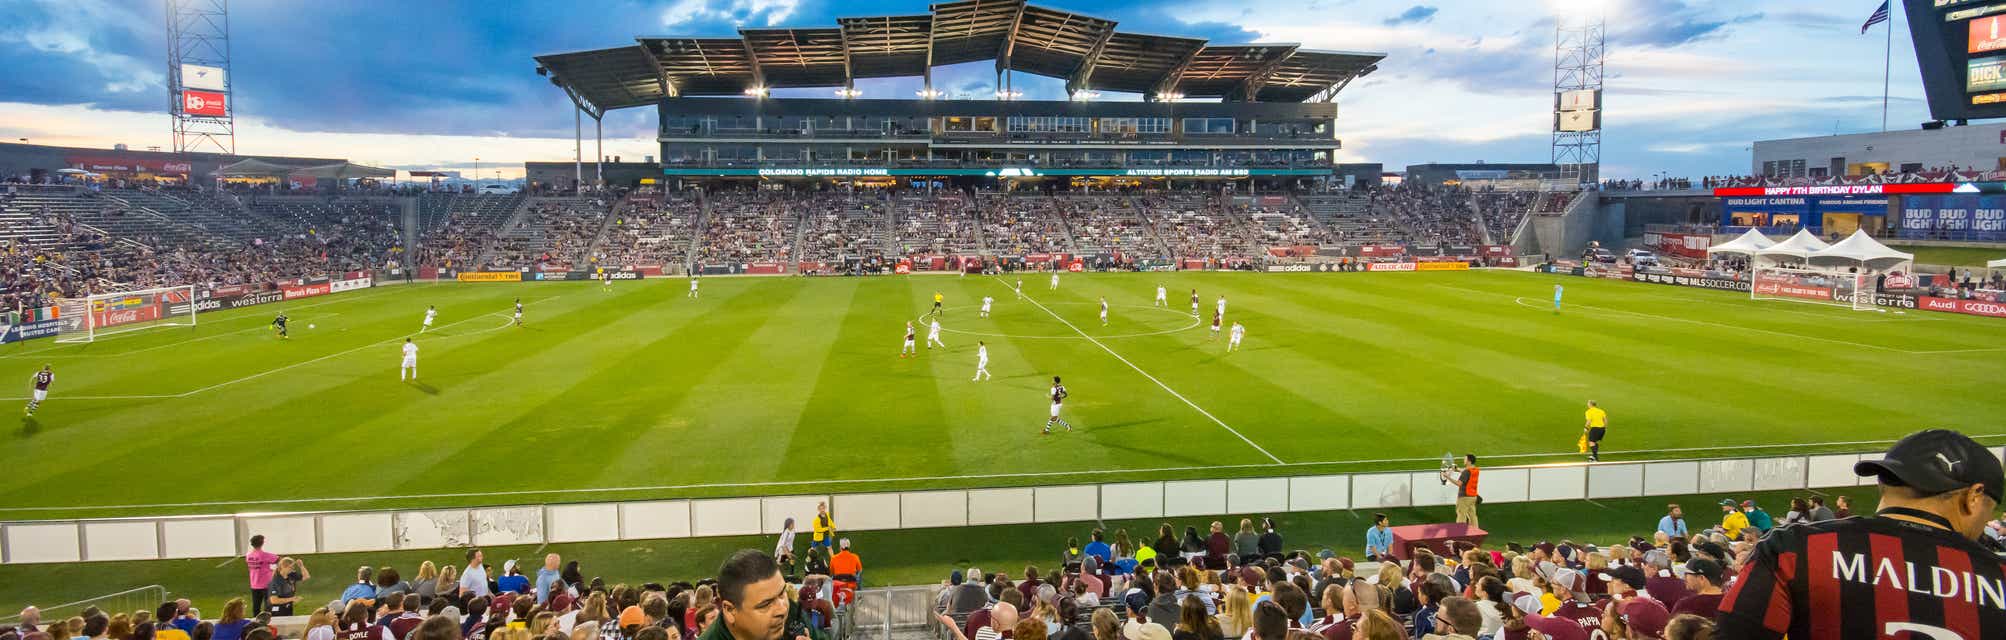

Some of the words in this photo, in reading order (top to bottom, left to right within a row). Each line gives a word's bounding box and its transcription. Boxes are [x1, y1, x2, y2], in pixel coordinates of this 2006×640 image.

[758, 168, 804, 176] COLORADO
[805, 168, 835, 176] RAPIDS
[837, 168, 862, 176] RADIO
[863, 168, 888, 176] HOME
[1127, 168, 1161, 176] ALTITUDE
[1163, 168, 1194, 176] SPORTS
[1195, 168, 1219, 176] RADIO
[1220, 168, 1232, 176] AM
[1764, 187, 1791, 195] HAPPY
[1791, 187, 1807, 195] 7TH
[1808, 186, 1850, 194] BIRTHDAY
[1851, 185, 1883, 193] DYLAN
[1905, 208, 1932, 219] BUD
[1939, 208, 1967, 219] BUD
[1975, 208, 2004, 219] BUD
[1902, 218, 1934, 229] LIGHT
[1284, 264, 1311, 272] adidas
[1690, 278, 1753, 291] MLSSOCCER.COM
[231, 292, 283, 308] westerra
[1833, 287, 1914, 308] westerra
[193, 299, 221, 311] adidas
[1929, 299, 1956, 309] Audi
[110, 310, 137, 324] Coca-Cola
[1832, 550, 2006, 610] MALDIN
[1577, 616, 1601, 628] PAPPA
[349, 630, 369, 640] DOYLE
